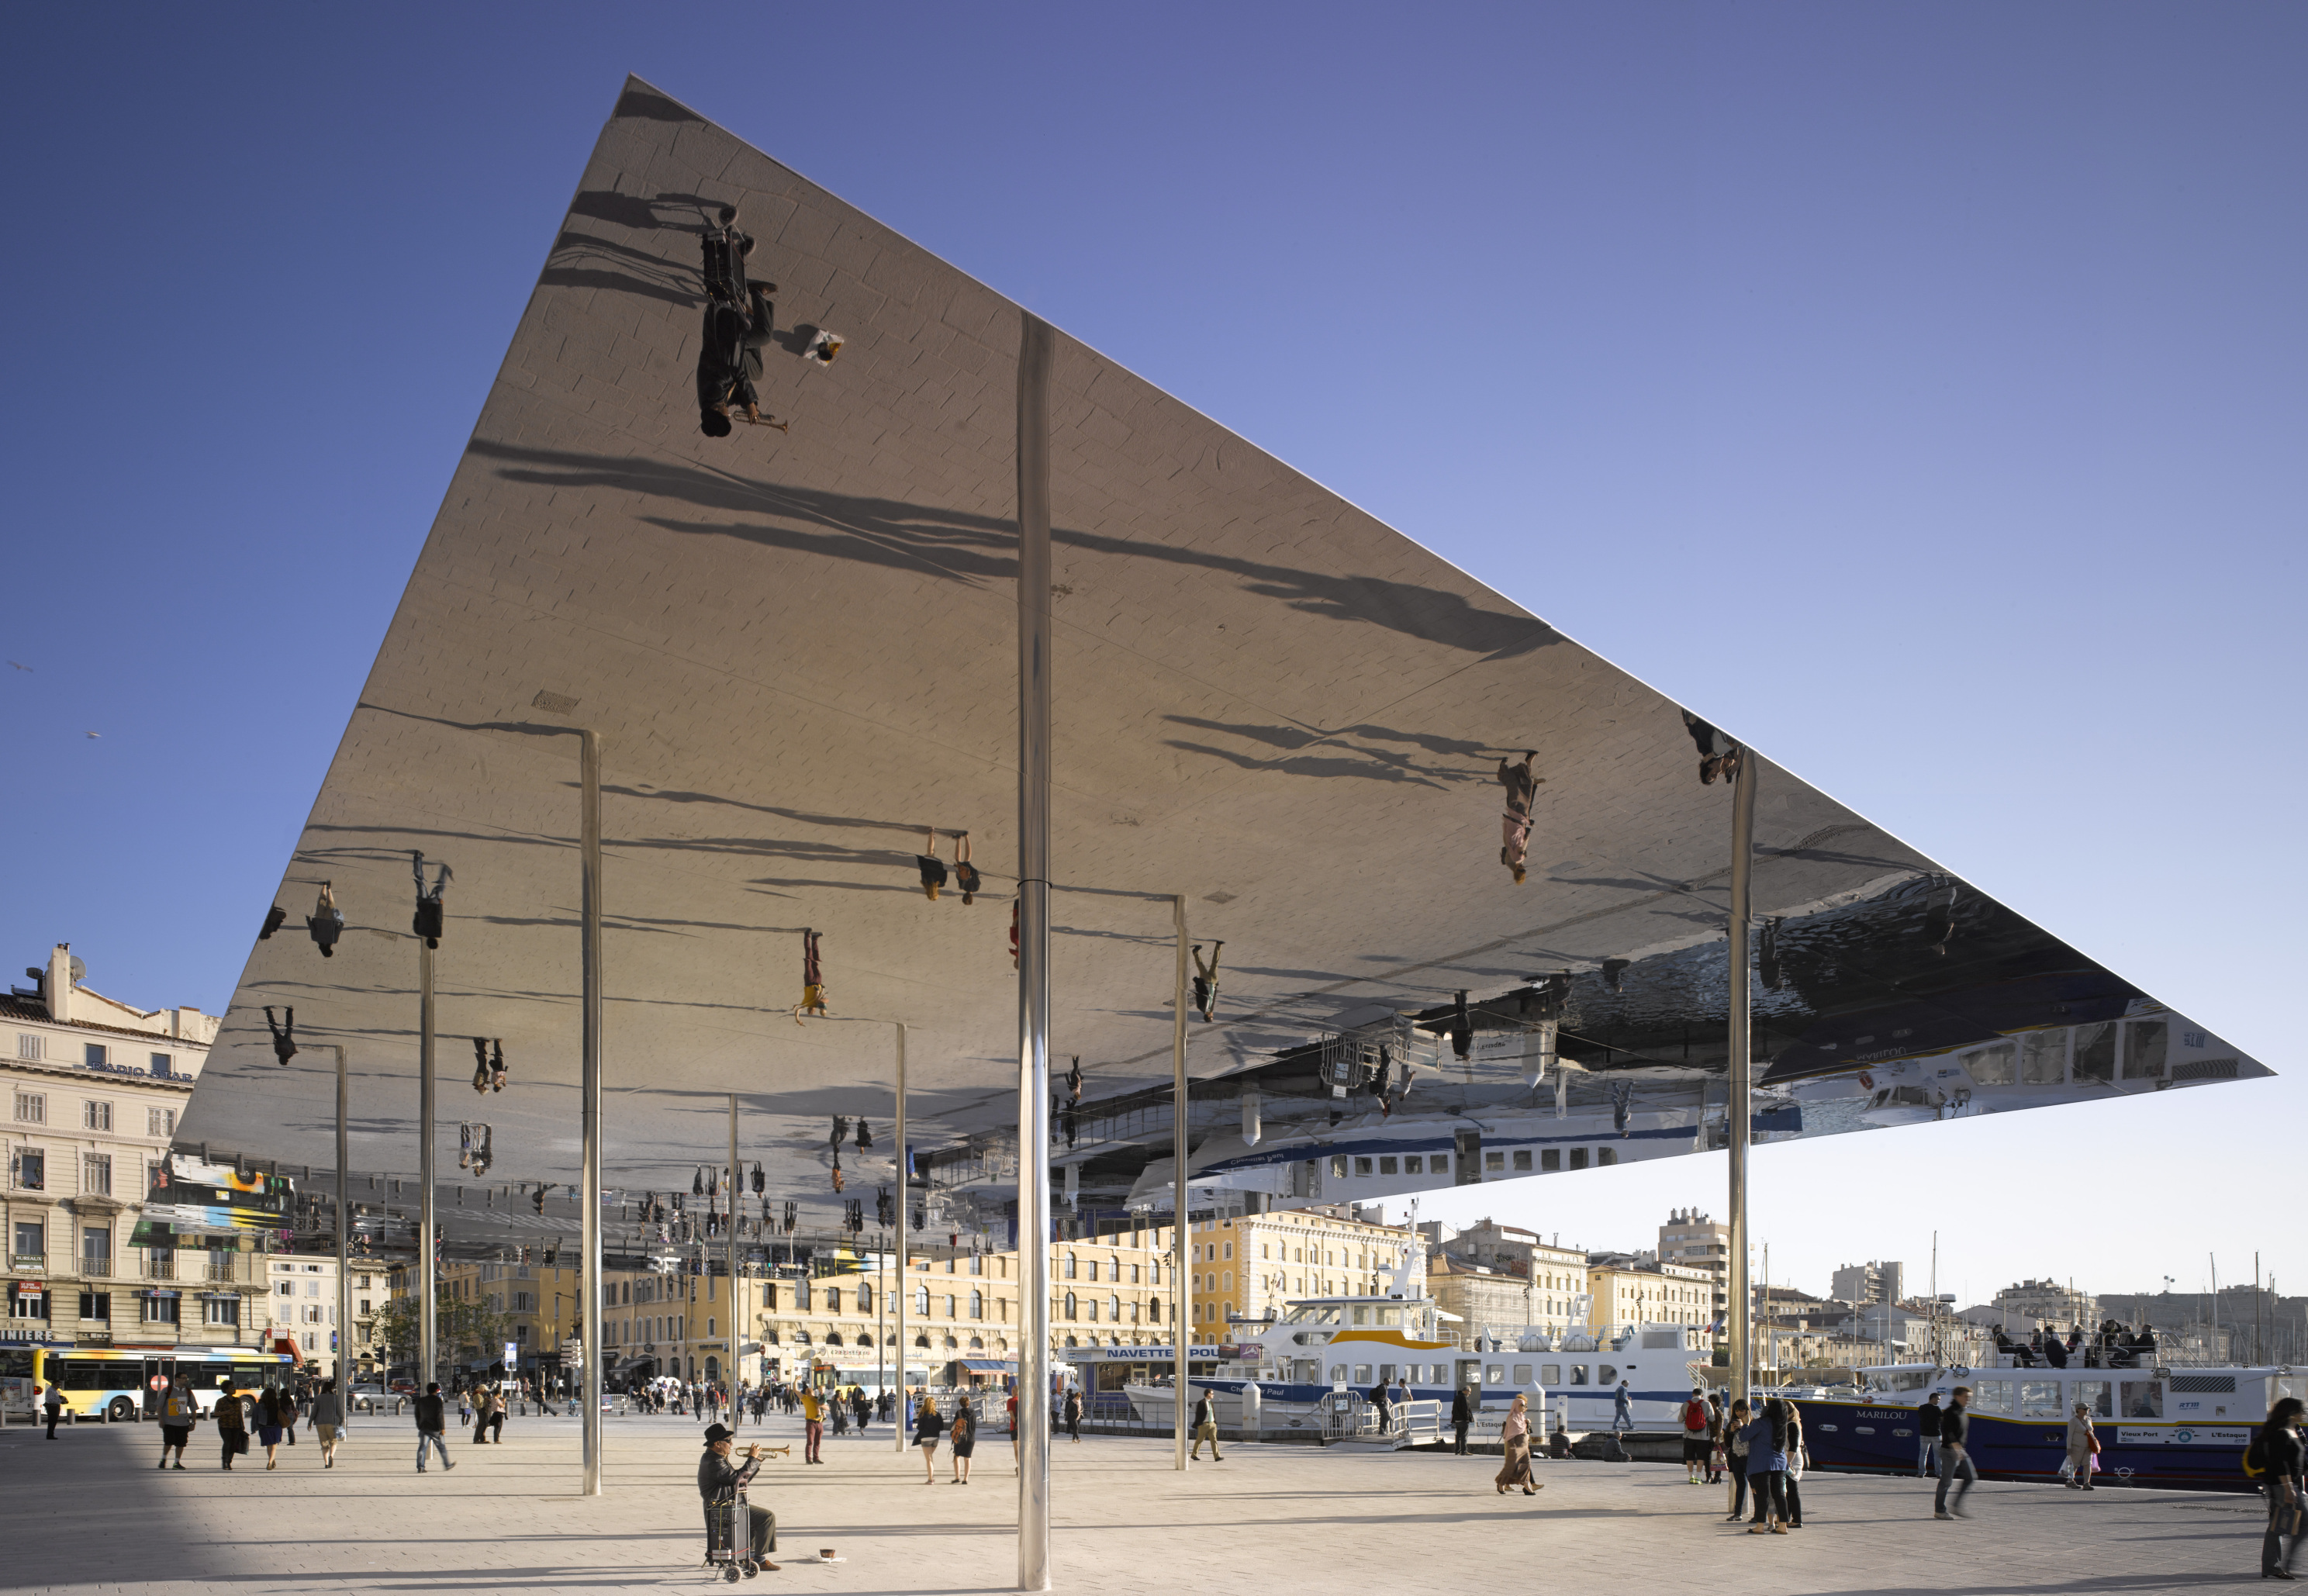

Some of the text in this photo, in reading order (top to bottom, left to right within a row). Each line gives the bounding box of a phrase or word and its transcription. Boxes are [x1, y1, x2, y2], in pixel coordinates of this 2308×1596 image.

[92, 1061, 193, 1083] RADIO STAR
[1, 1330, 52, 1341] INIERE
[1107, 1349, 1175, 1358] NAVETTE
[1856, 1410, 1908, 1420] MARILOU
